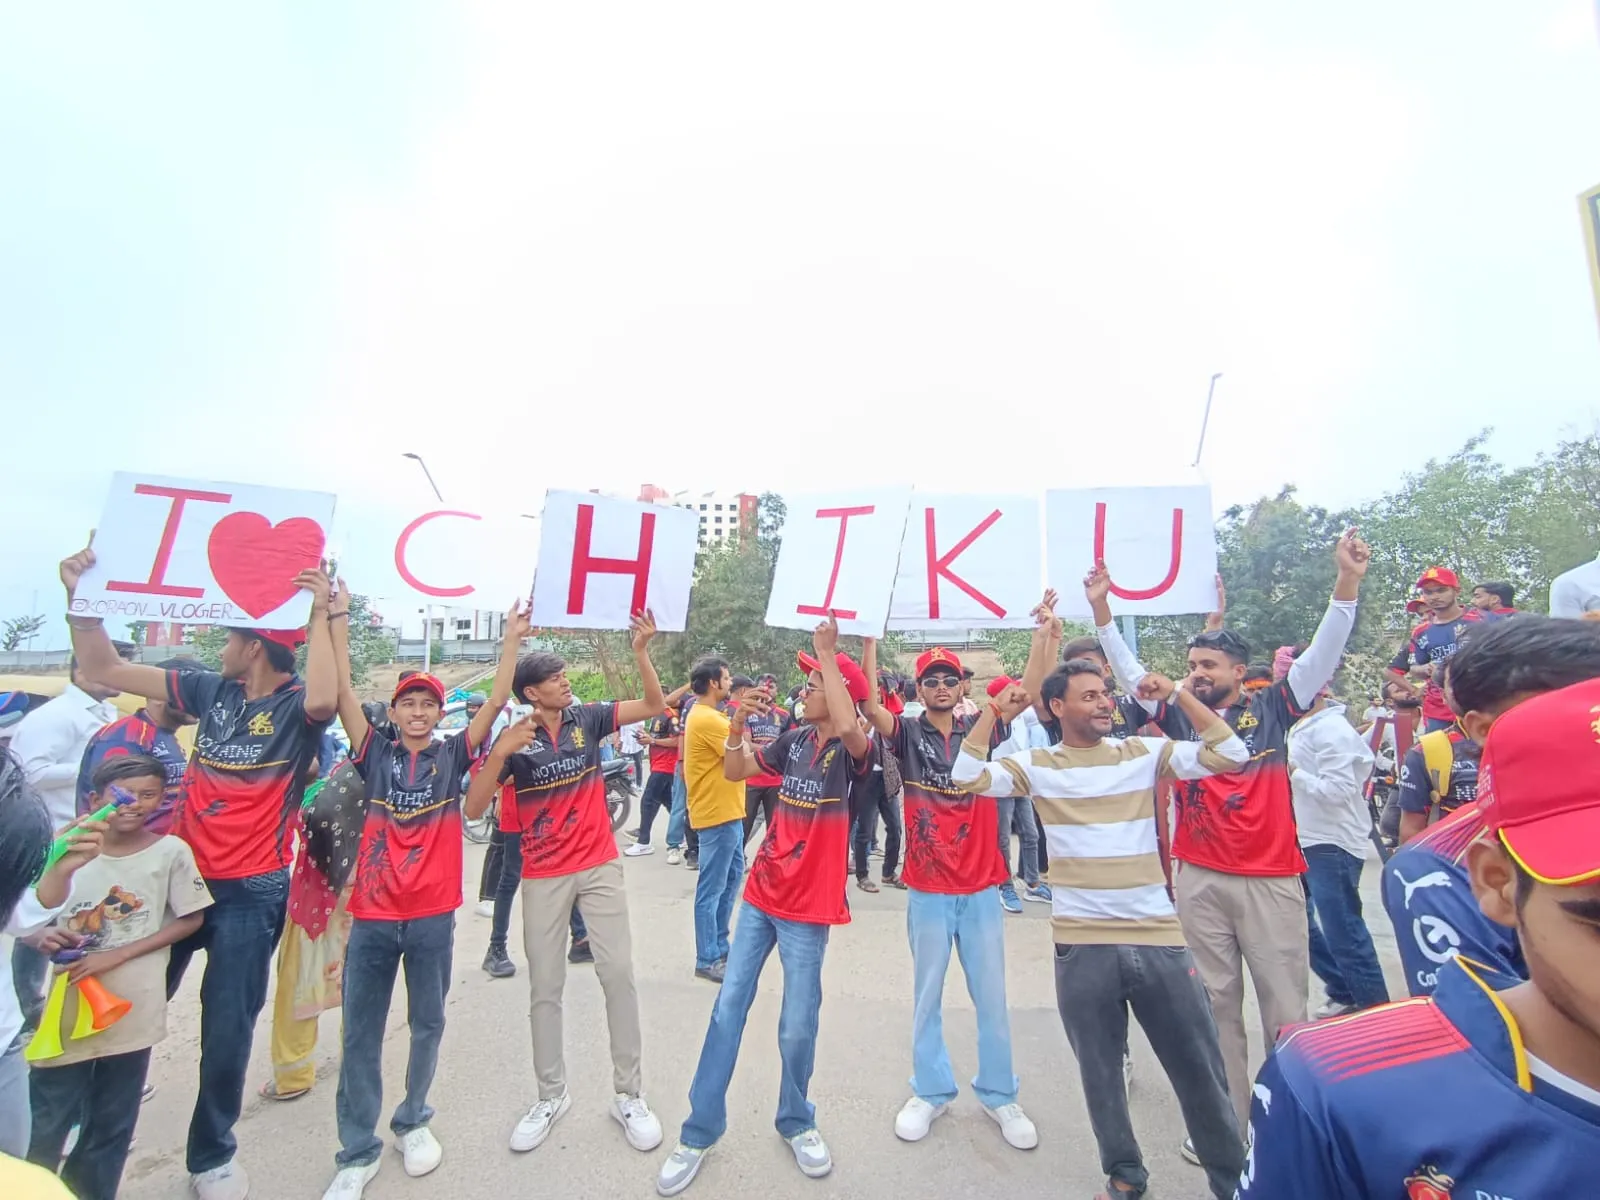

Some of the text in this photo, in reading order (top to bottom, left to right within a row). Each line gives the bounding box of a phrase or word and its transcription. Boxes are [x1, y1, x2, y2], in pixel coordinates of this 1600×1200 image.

[107, 484, 230, 598] I
[395, 510, 481, 597] C
[567, 504, 656, 616] H
[796, 505, 875, 620] I
[925, 507, 1007, 619] K
[1094, 503, 1184, 600] U
